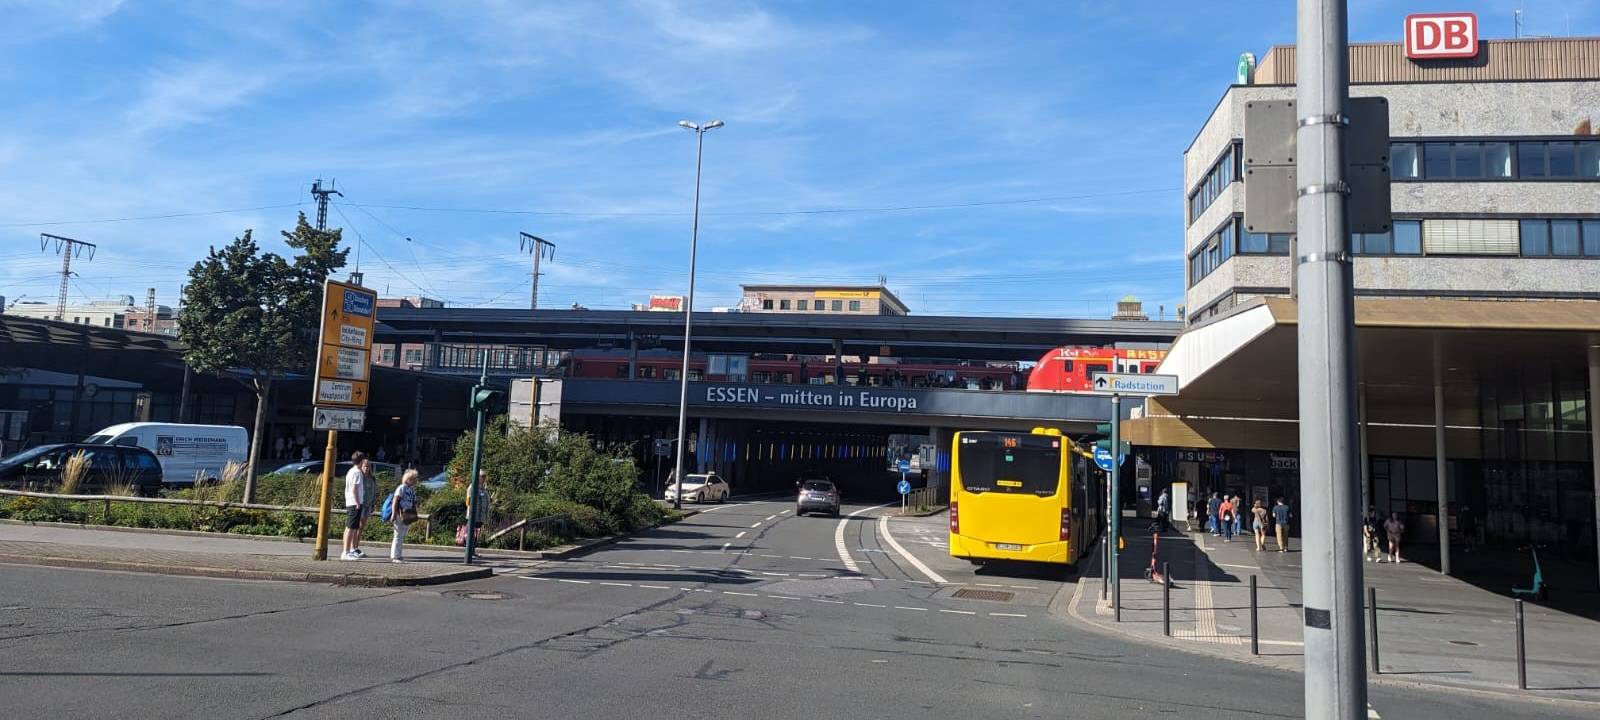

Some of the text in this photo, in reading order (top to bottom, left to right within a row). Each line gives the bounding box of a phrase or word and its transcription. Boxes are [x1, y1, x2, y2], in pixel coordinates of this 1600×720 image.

[1416, 21, 1469, 50] DB
[1114, 380, 1165, 391] Radstation
[706, 387, 759, 403] ESSEN
[780, 389, 833, 406] mitten
[839, 391, 853, 406] in
[860, 392, 917, 411] Europa
[1003, 438, 1017, 448] 146
